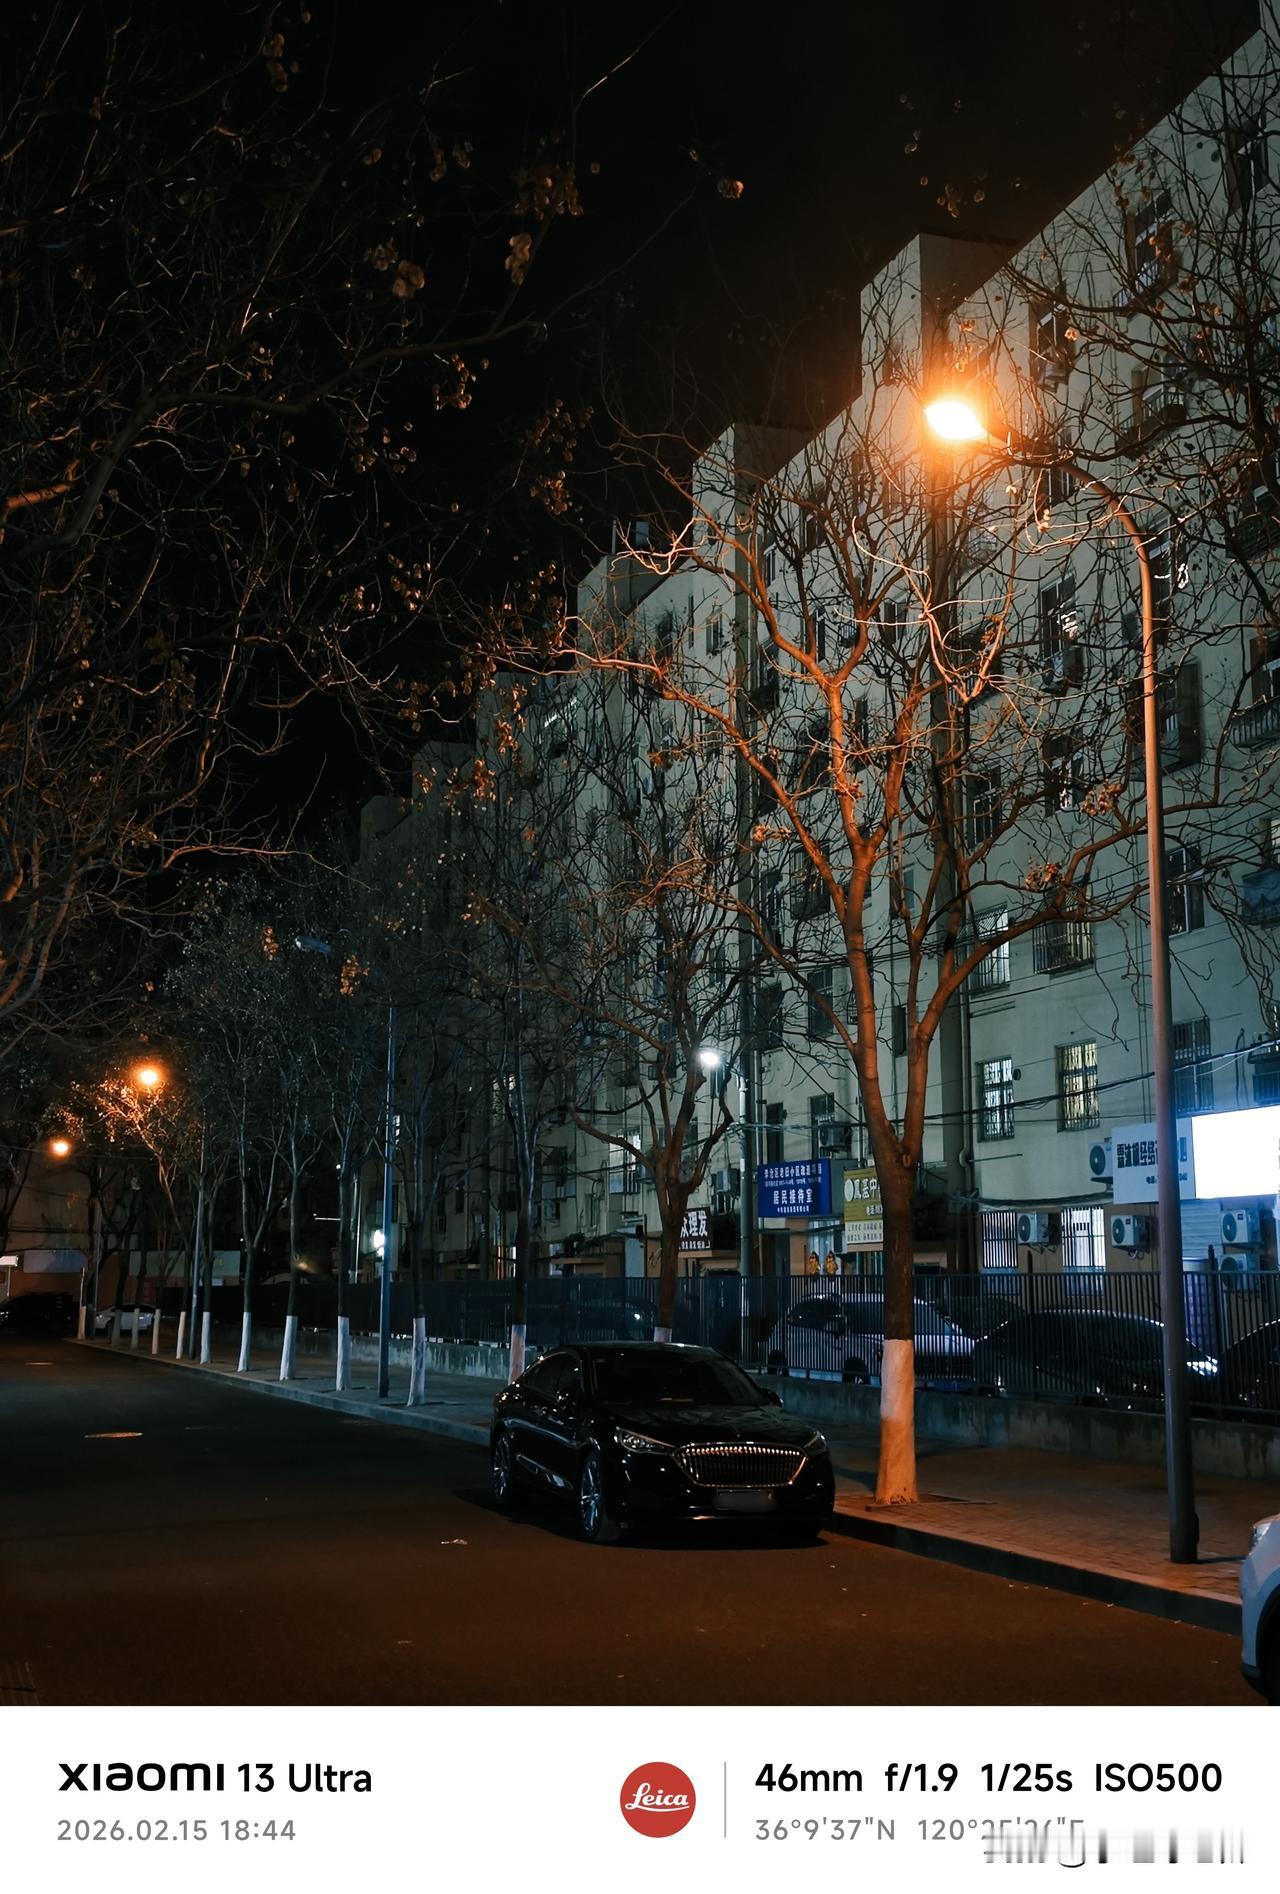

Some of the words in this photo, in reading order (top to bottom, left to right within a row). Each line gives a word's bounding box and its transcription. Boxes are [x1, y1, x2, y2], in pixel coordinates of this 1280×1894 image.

[773, 1188, 813, 1205] 居民接待室
